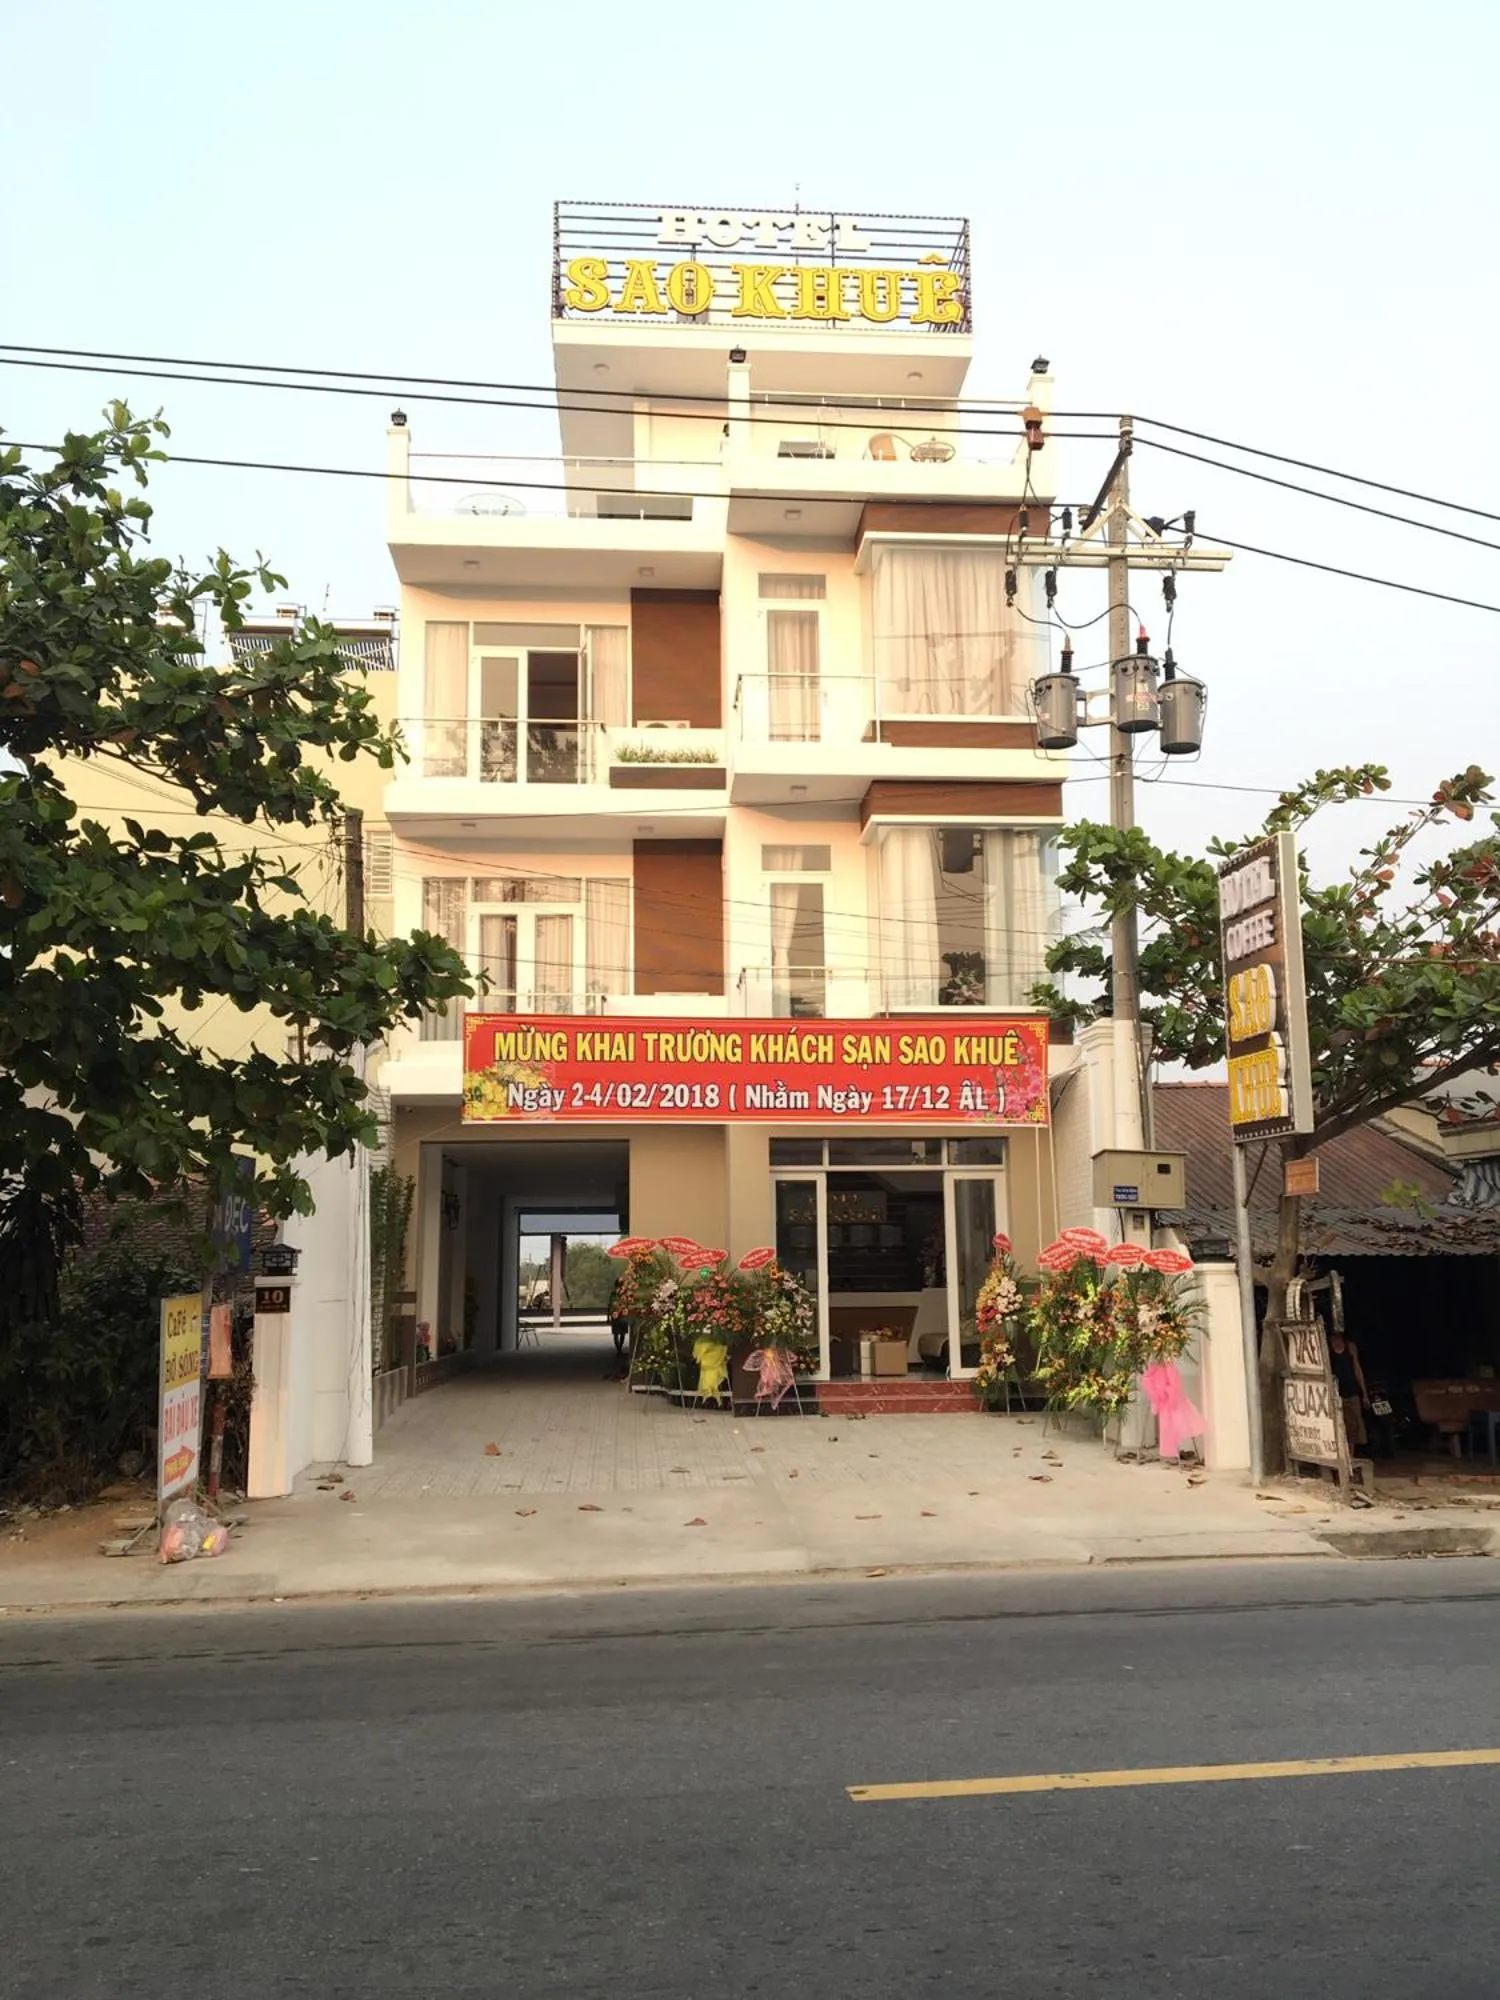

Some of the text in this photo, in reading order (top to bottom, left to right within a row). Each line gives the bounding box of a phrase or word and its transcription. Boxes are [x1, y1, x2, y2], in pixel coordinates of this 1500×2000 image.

[656, 213, 871, 251] HOTEL
[565, 252, 962, 325] SAO KHUÊ
[1228, 963, 1277, 1042] SAO
[494, 1023, 1019, 1071] MỪNG KHAI TRƯƠNG KHÁCH SẠN SAO KHUÊ
[508, 1082, 565, 1112] Ngày
[744, 1080, 809, 1109] Nhằm
[816, 1084, 873, 1114] Ngày
[881, 1085, 950, 1111] 17/12
[959, 1079, 989, 1111] ÂL
[260, 1289, 286, 1305] 10
